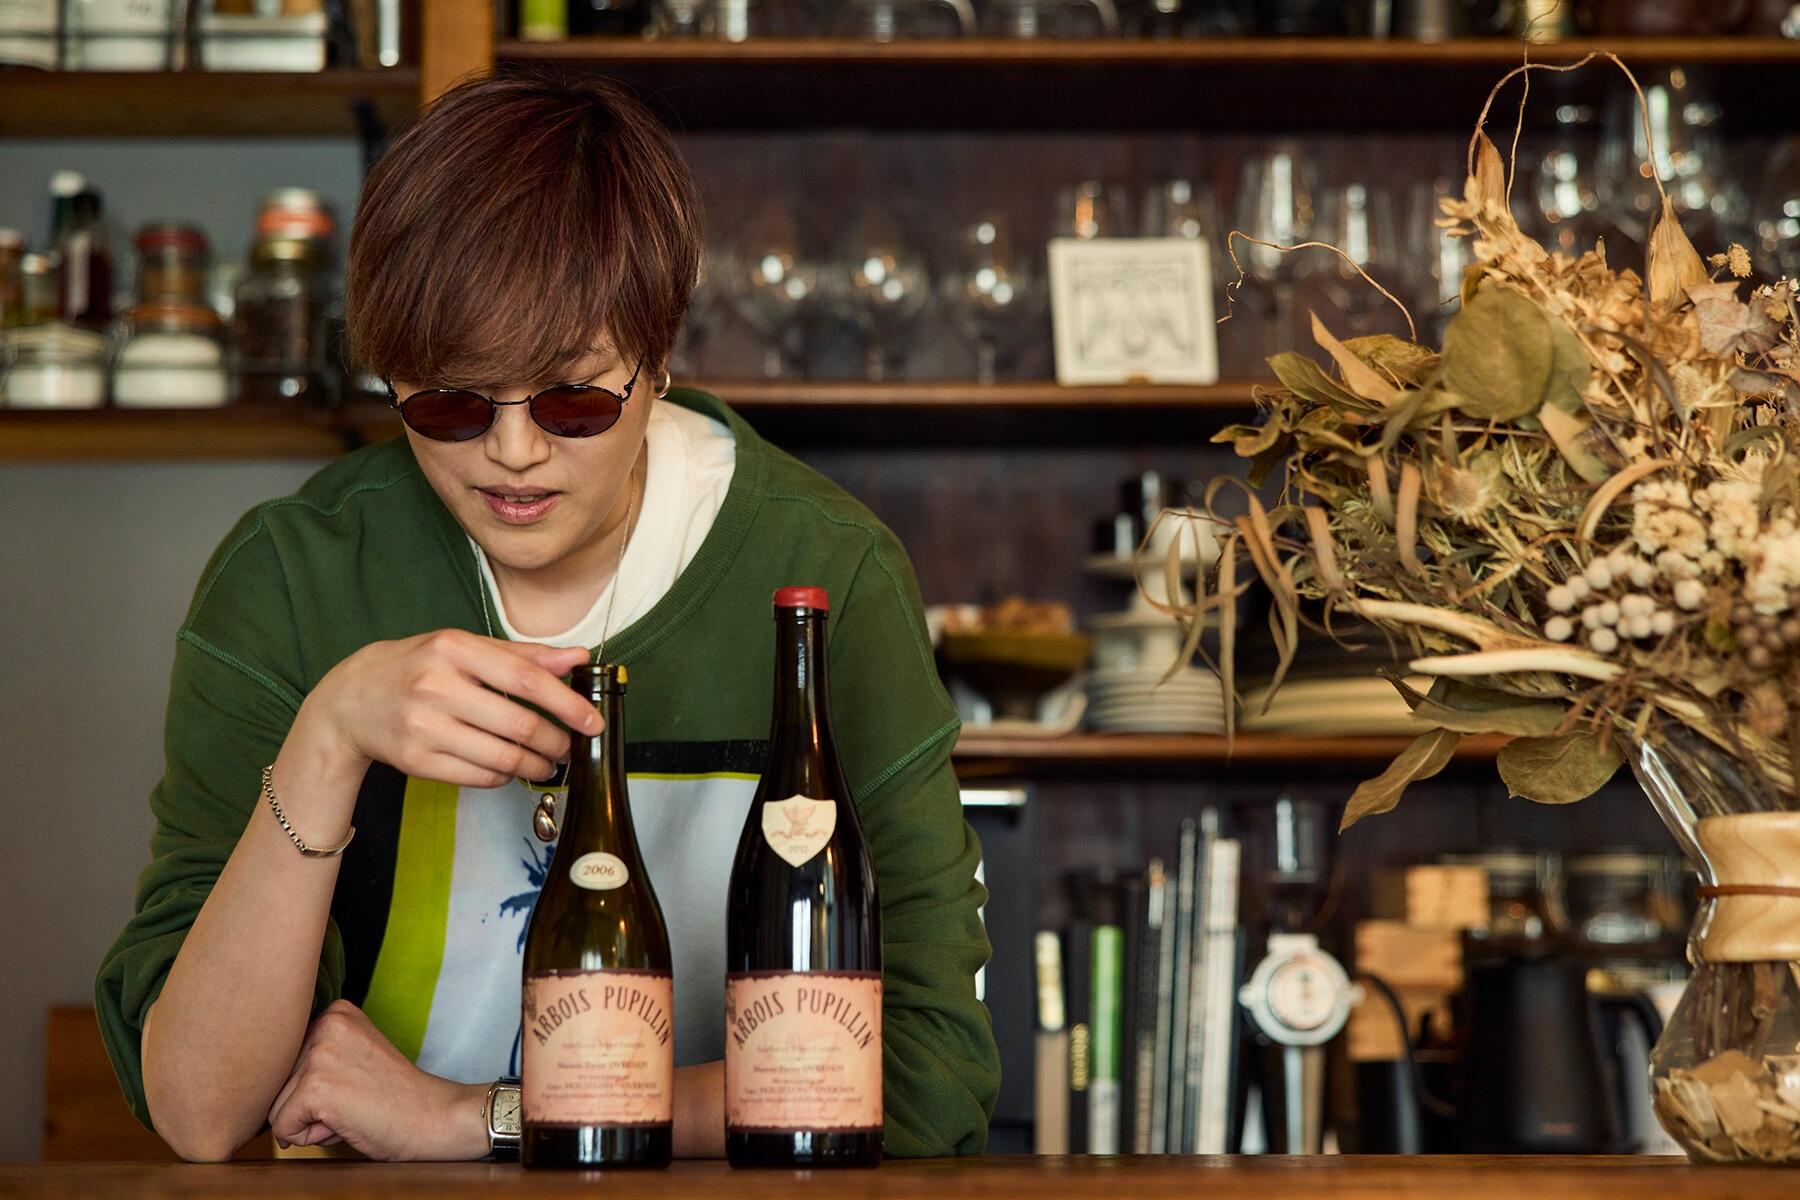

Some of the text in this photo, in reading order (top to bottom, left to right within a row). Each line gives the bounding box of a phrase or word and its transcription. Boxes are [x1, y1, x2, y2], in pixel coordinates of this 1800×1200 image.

[583, 864, 614, 876] 2006
[532, 985, 671, 1047] ARBOIS PUPILLIN
[733, 988, 874, 1050] ARBOIS PUPILLIN
